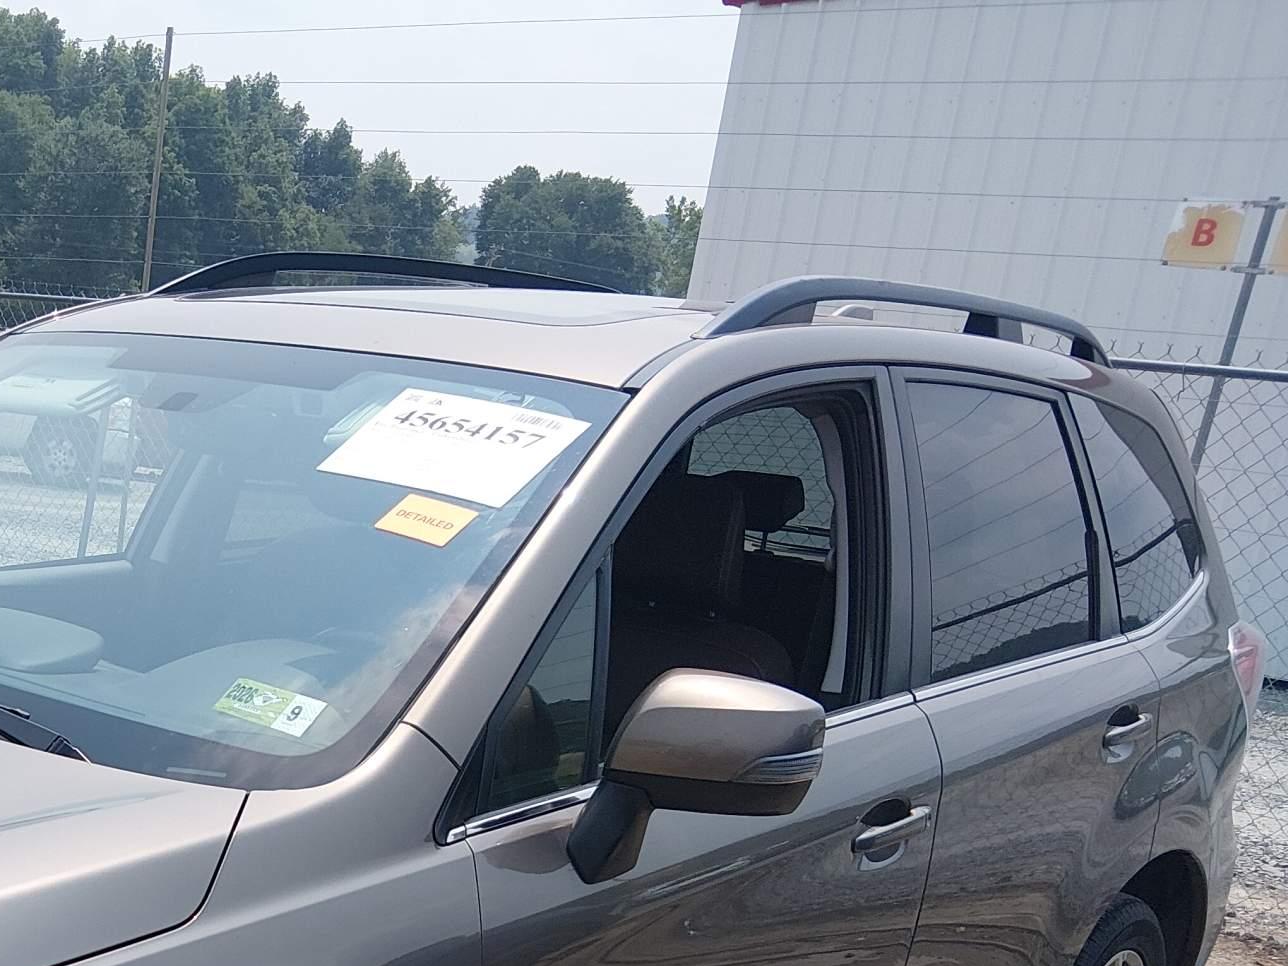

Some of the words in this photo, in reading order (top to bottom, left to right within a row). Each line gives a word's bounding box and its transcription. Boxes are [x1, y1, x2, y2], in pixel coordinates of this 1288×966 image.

[1191, 218, 1217, 247] B
[394, 410, 547, 449] 45654157
[395, 508, 455, 531] DETAILED
[286, 705, 304, 722] 9
